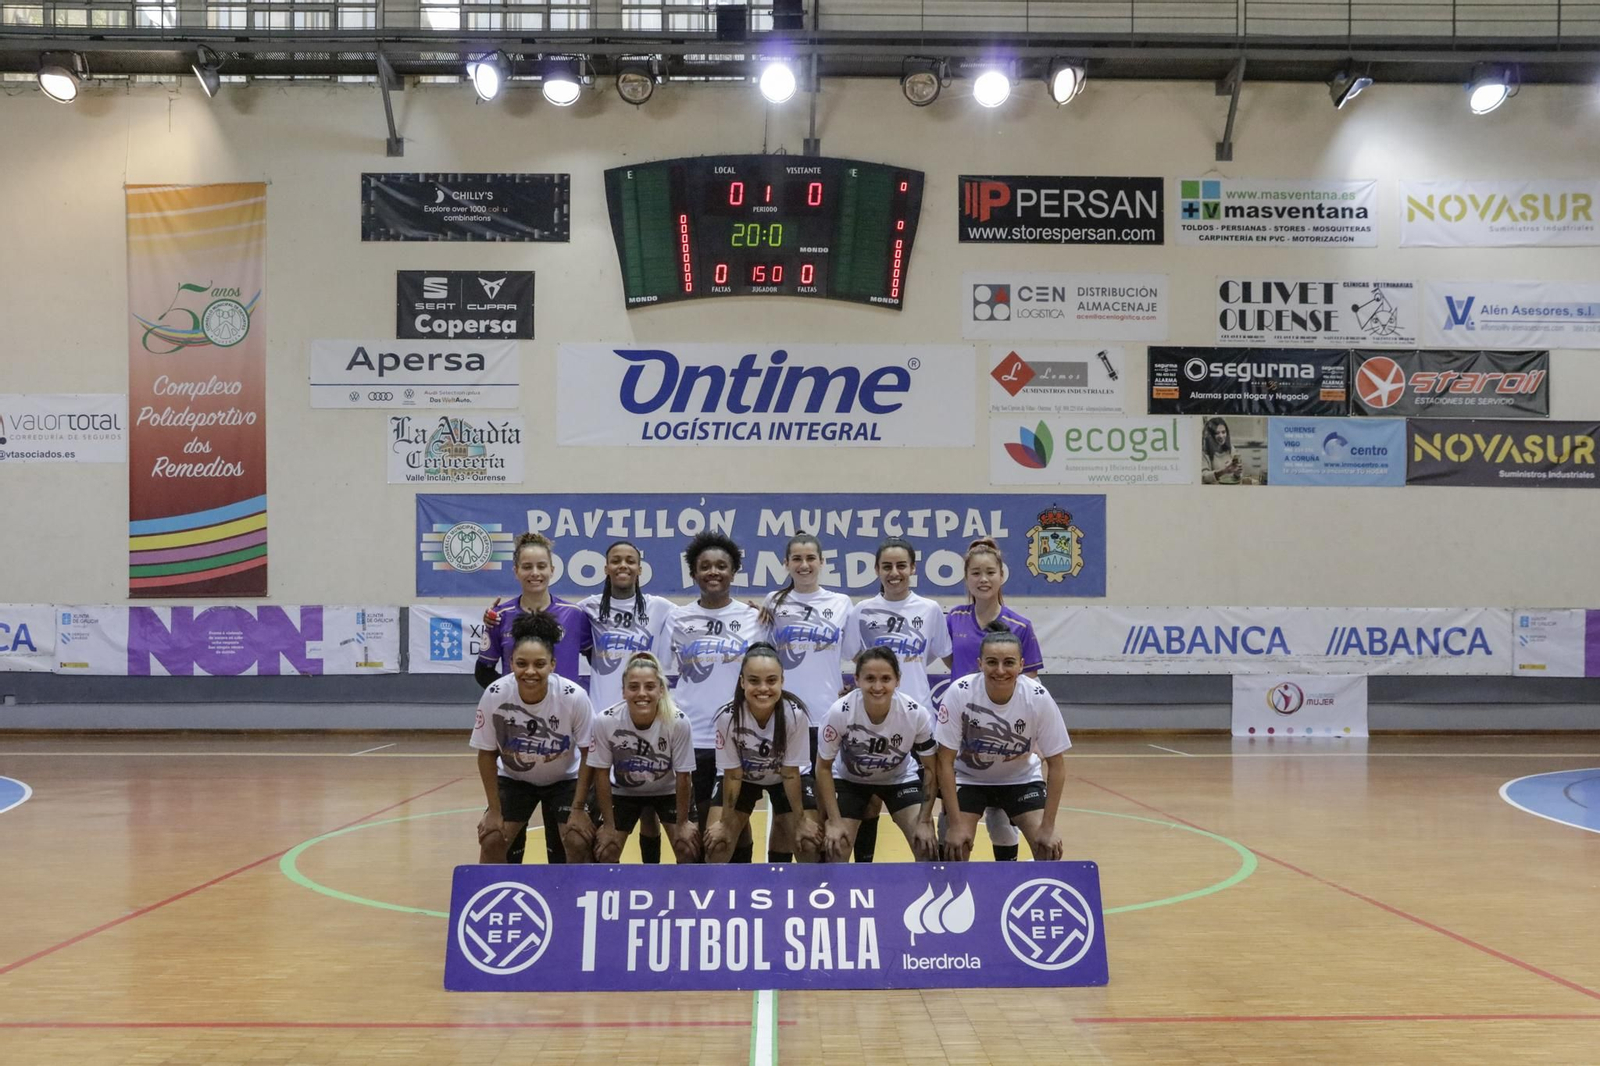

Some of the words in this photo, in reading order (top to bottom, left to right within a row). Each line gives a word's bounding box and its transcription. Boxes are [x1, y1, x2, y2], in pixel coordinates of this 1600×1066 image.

[627, 170, 633, 180] E
[714, 166, 736, 174] LOCAL
[786, 166, 822, 175] VISITANTE
[851, 169, 858, 178] E
[451, 191, 494, 201] CHILLY'S
[729, 182, 744, 206] 0
[766, 185, 772, 203] 1
[808, 182, 822, 206] 0
[1225, 189, 1357, 201] www.masventana.es
[424, 205, 451, 215] Explore
[469, 205, 487, 213] 1000
[1016, 188, 1158, 219] PERSAN
[1224, 203, 1369, 220] masventana
[1406, 193, 1593, 222] NOVASUR
[443, 214, 492, 222] combinations
[731, 224, 782, 247] 20:0
[968, 225, 1156, 244] www.storespersan.com
[1542, 224, 1595, 232] Industriales
[1198, 234, 1253, 242] CARPINTERÍA
[1292, 235, 1354, 243] MOTORIZACIÓN
[715, 264, 728, 284] 0
[801, 264, 814, 284] 0
[711, 286, 732, 294] FALTAS
[751, 286, 778, 294] JUGADOR
[797, 286, 818, 294] FALTAS
[1017, 286, 1066, 303] CEN
[1076, 286, 1158, 298] DISTRIBUCIÓN
[1218, 280, 1339, 305] CLIVET
[414, 302, 457, 311] SEAT
[466, 303, 518, 311] CUPRA
[1076, 302, 1157, 313] ALMACENAJE
[1480, 304, 1508, 316] Alén
[1511, 305, 1573, 318] Asesores,
[414, 314, 518, 338] Copersa
[1218, 308, 1340, 333] OURENSE
[345, 347, 486, 378] Apersa
[1039, 366, 1081, 380] Lemos
[1208, 362, 1316, 383] segurma
[152, 375, 243, 401] Complexo
[612, 349, 912, 415] Ontime
[1408, 370, 1546, 394] staroil
[1066, 388, 1115, 396] INDUSTRIALES
[1189, 391, 1222, 401] Alarmas
[1222, 393, 1243, 402] para
[1243, 392, 1268, 402] Hogar
[1268, 394, 1275, 402] y
[1275, 392, 1310, 402] Negocio
[1414, 397, 1465, 405] ESTACIONES
[1477, 398, 1515, 406] SERVICIO
[9, 413, 122, 431] valortotal
[137, 406, 257, 432] Polideportivo
[390, 416, 428, 455] La
[431, 416, 522, 455] Abadía
[641, 416, 762, 442] LOGÍSTICA
[768, 421, 883, 442] INTEGRAL
[183, 436, 212, 453] dos
[1065, 418, 1180, 462] ecogal
[1350, 445, 1388, 456] centro
[1413, 433, 1596, 465] NOVASUR
[151, 456, 245, 478] Remedios
[1498, 470, 1546, 479] Suministros
[1547, 470, 1596, 480] Industriales
[405, 474, 425, 482] Valle
[455, 474, 465, 482] 43
[472, 473, 506, 482] Ourense
[1087, 472, 1159, 484] www.ecogal.es
[526, 497, 737, 543] PAVILLÓN
[756, 507, 1009, 543] MUNICIPAL
[613, 611, 633, 629] 98
[803, 606, 813, 622] 7
[704, 620, 723, 637] 20
[886, 616, 906, 634] 97
[127, 605, 324, 676] NON
[526, 719, 538, 737] 9
[759, 739, 770, 758] 6
[868, 738, 887, 754] 10
[628, 882, 875, 910] DIVISIÓN
[626, 909, 771, 972] FÚTBOL
[784, 916, 881, 971] SALA
[902, 953, 981, 970] Iberdrola
